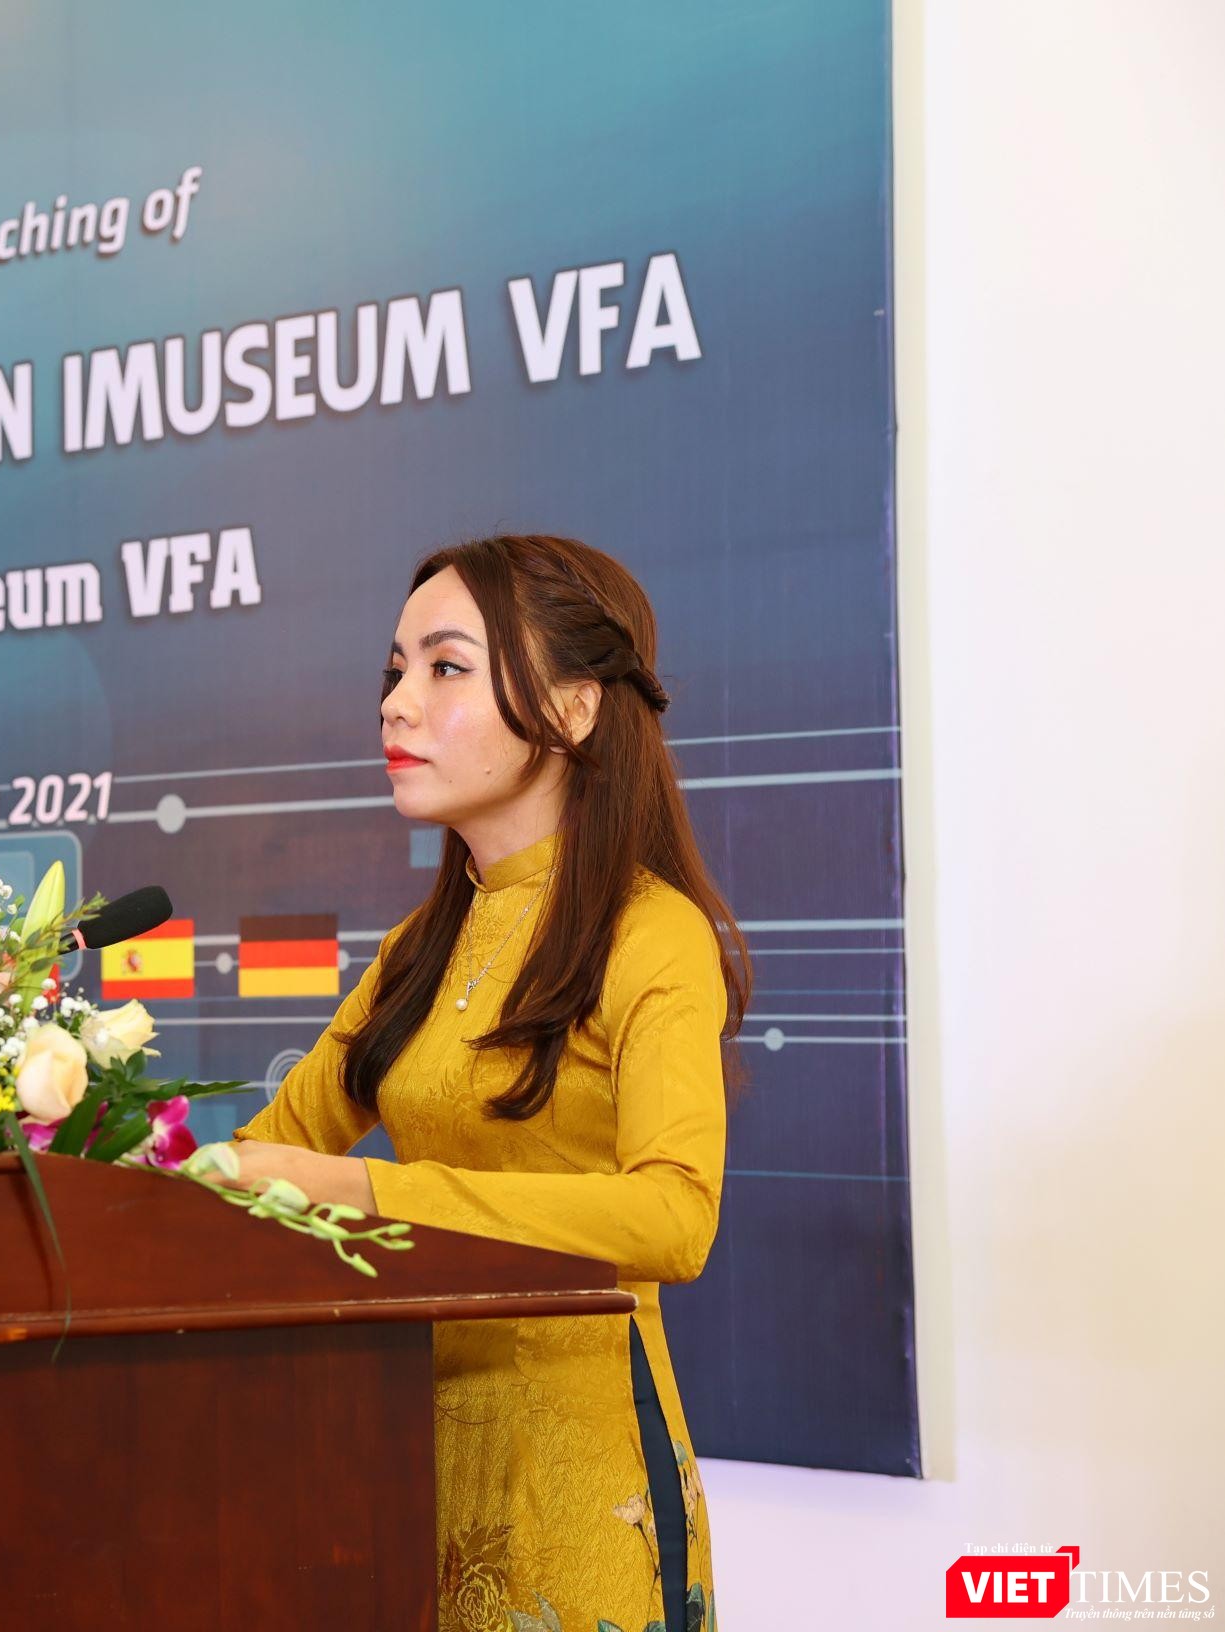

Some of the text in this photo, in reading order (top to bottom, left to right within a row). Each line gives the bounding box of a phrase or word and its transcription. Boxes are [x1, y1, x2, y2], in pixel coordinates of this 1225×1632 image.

[142, 166, 203, 241] of
[64, 289, 471, 452] IMUSEUM
[508, 253, 702, 383] VFA
[122, 527, 261, 617] VFA
[9, 772, 112, 825] 2021
